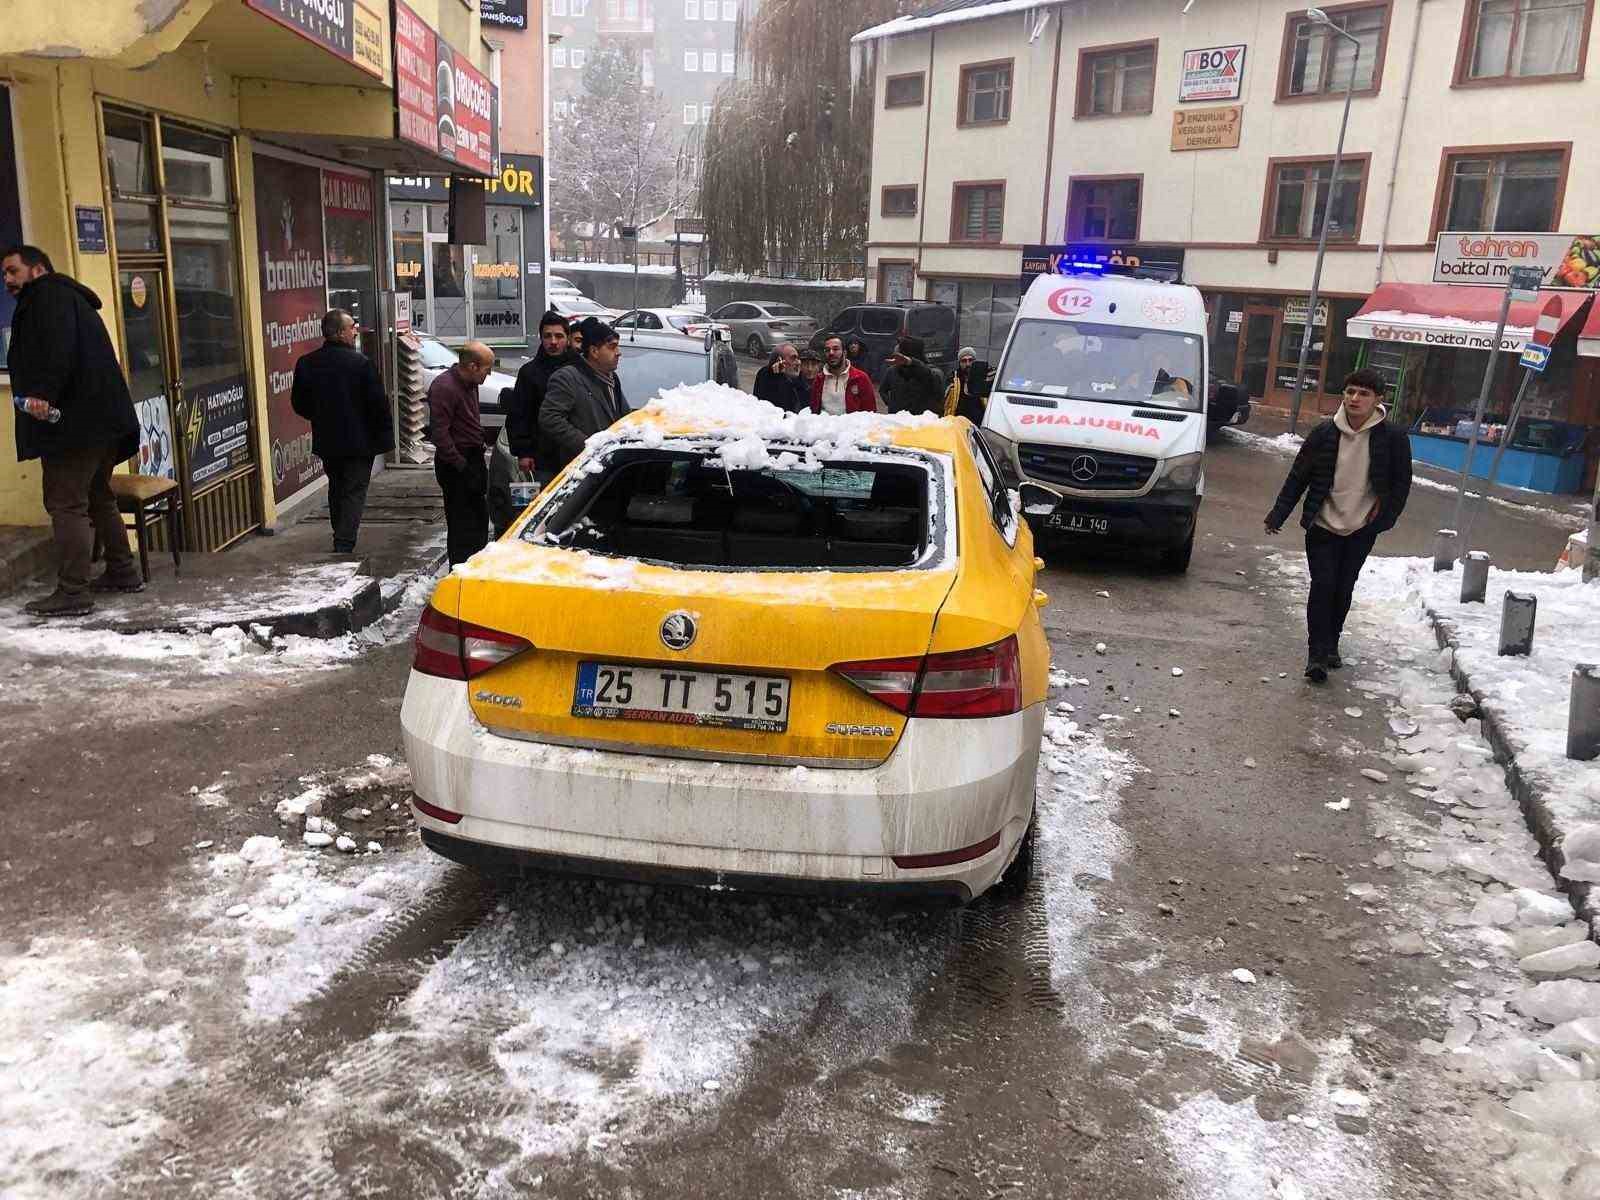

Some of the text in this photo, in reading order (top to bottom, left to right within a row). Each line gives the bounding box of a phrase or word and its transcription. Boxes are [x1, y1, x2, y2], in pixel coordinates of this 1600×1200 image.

[1458, 236, 1539, 258] tahran
[265, 249, 324, 292] banlüks
[1060, 295, 1093, 308] 112
[1371, 325, 1423, 342] tahran
[1048, 514, 1062, 525] 25
[1070, 515, 1084, 528] AJ
[1090, 518, 1108, 530] 140
[580, 688, 593, 700] TR
[596, 670, 782, 716] 25 TT 515
[624, 709, 667, 721] SERKAN
[669, 712, 696, 725] AUTO
[824, 723, 895, 737] SUPERB
